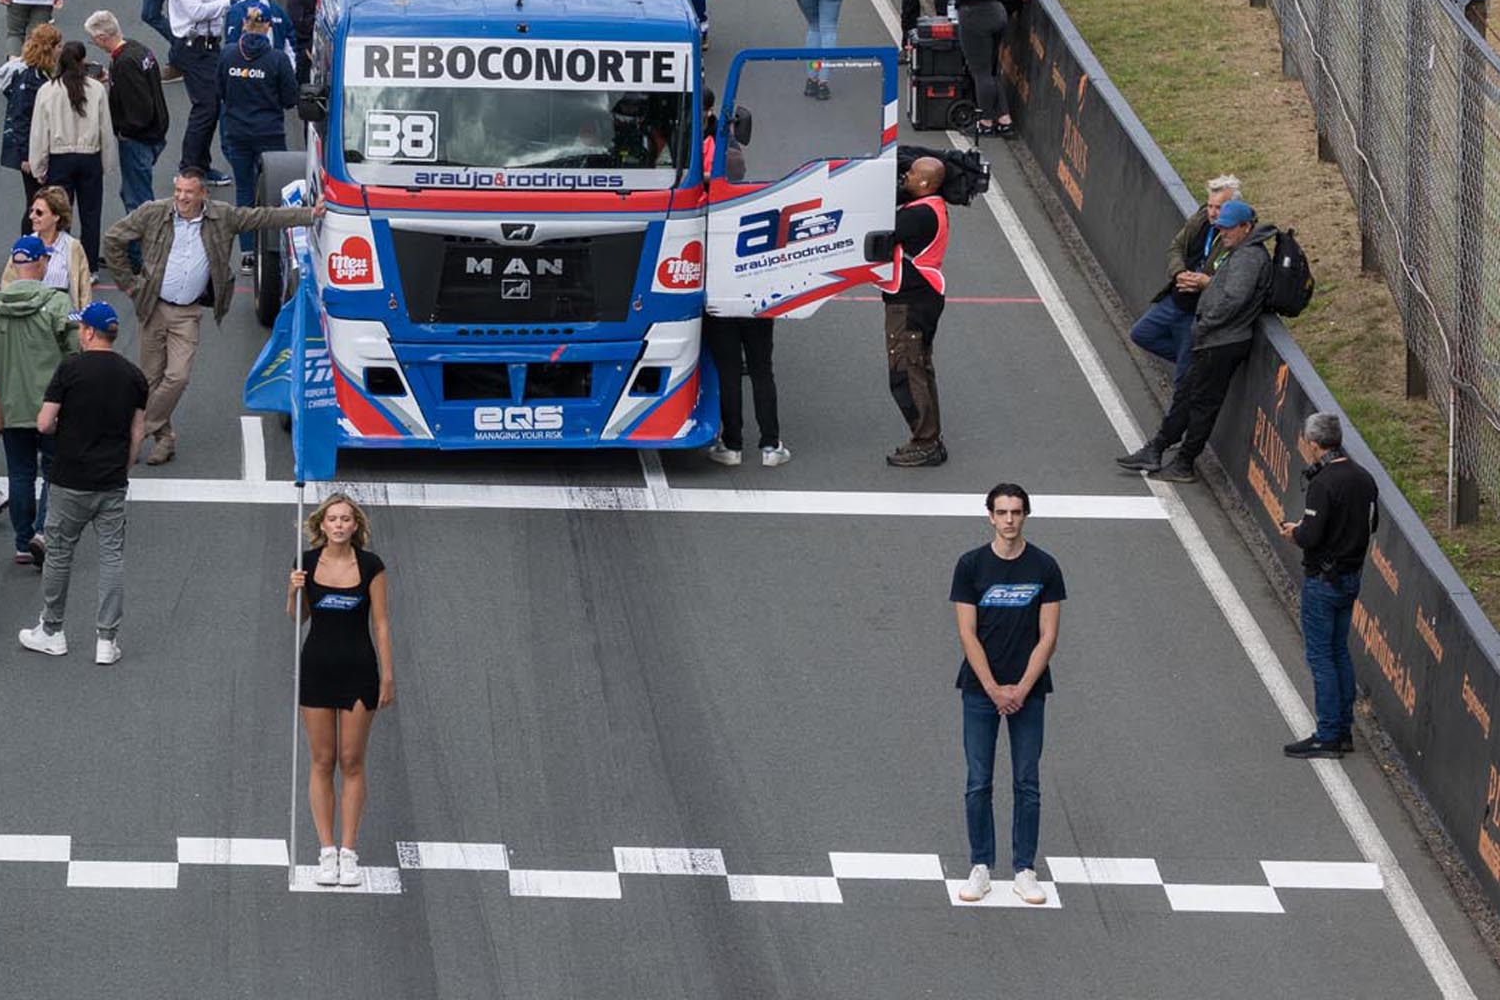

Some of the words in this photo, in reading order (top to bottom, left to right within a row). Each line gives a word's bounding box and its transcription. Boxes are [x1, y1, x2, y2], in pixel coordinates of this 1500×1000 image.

[364, 45, 675, 84] REBOCONORTE
[369, 115, 434, 158] 38
[414, 171, 624, 190] araújo&rodrigues
[331, 254, 368, 271] Meu
[734, 238, 854, 273] araújo&rodrigues
[336, 266, 368, 280] super
[466, 257, 563, 275] MAN
[475, 431, 519, 440] MANAGING
[521, 431, 543, 440] YOUR
[545, 431, 563, 440] RISK
